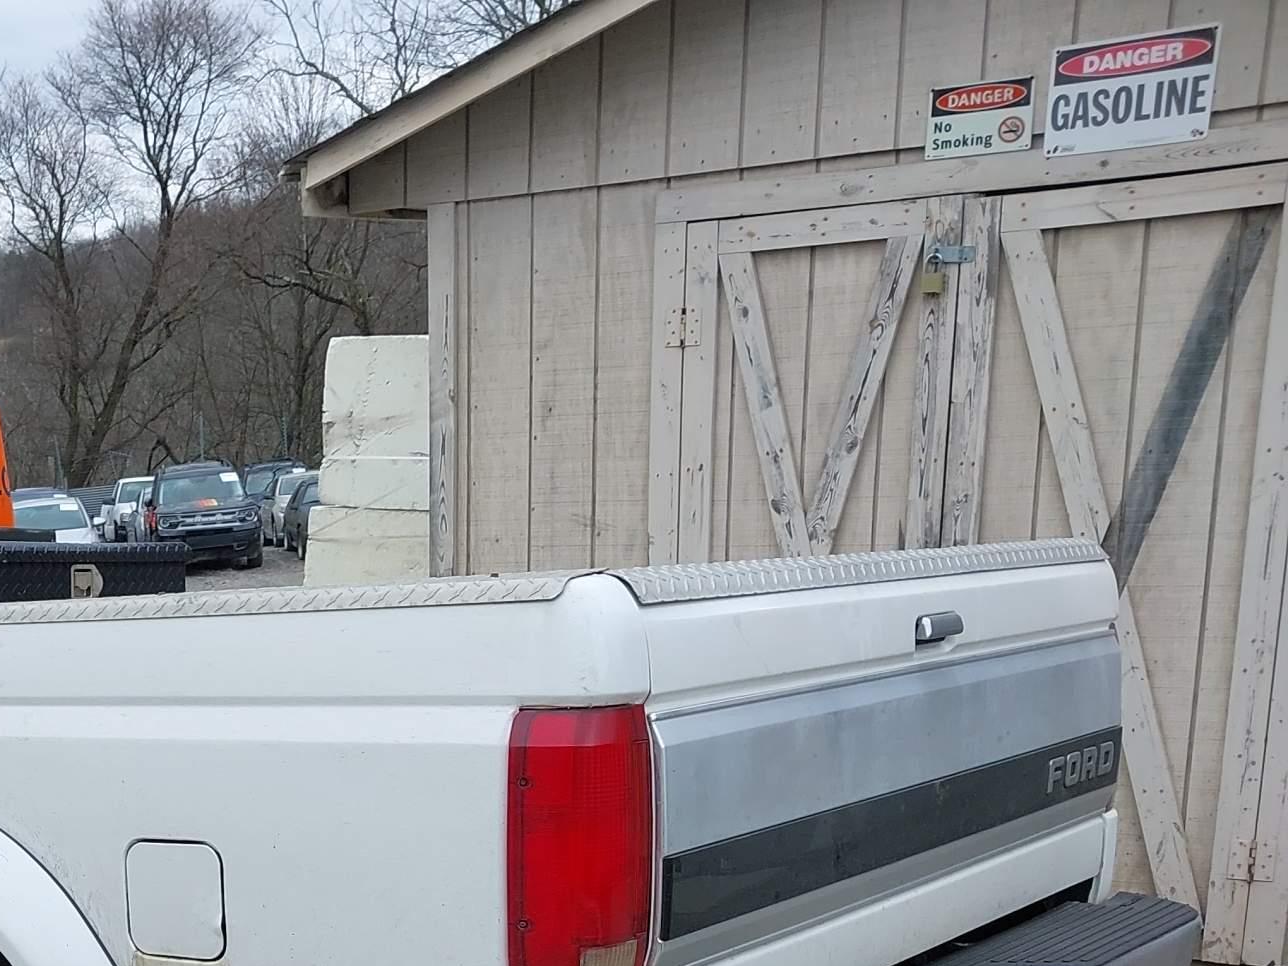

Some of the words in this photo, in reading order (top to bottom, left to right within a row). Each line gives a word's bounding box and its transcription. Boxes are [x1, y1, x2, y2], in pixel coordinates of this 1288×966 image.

[1082, 42, 1184, 74] DANGER
[947, 87, 1014, 107] DANGER
[1050, 74, 1210, 132] GASOLINE
[933, 121, 952, 134] No
[932, 133, 994, 151] Smoking
[1047, 741, 1115, 794] FORD
